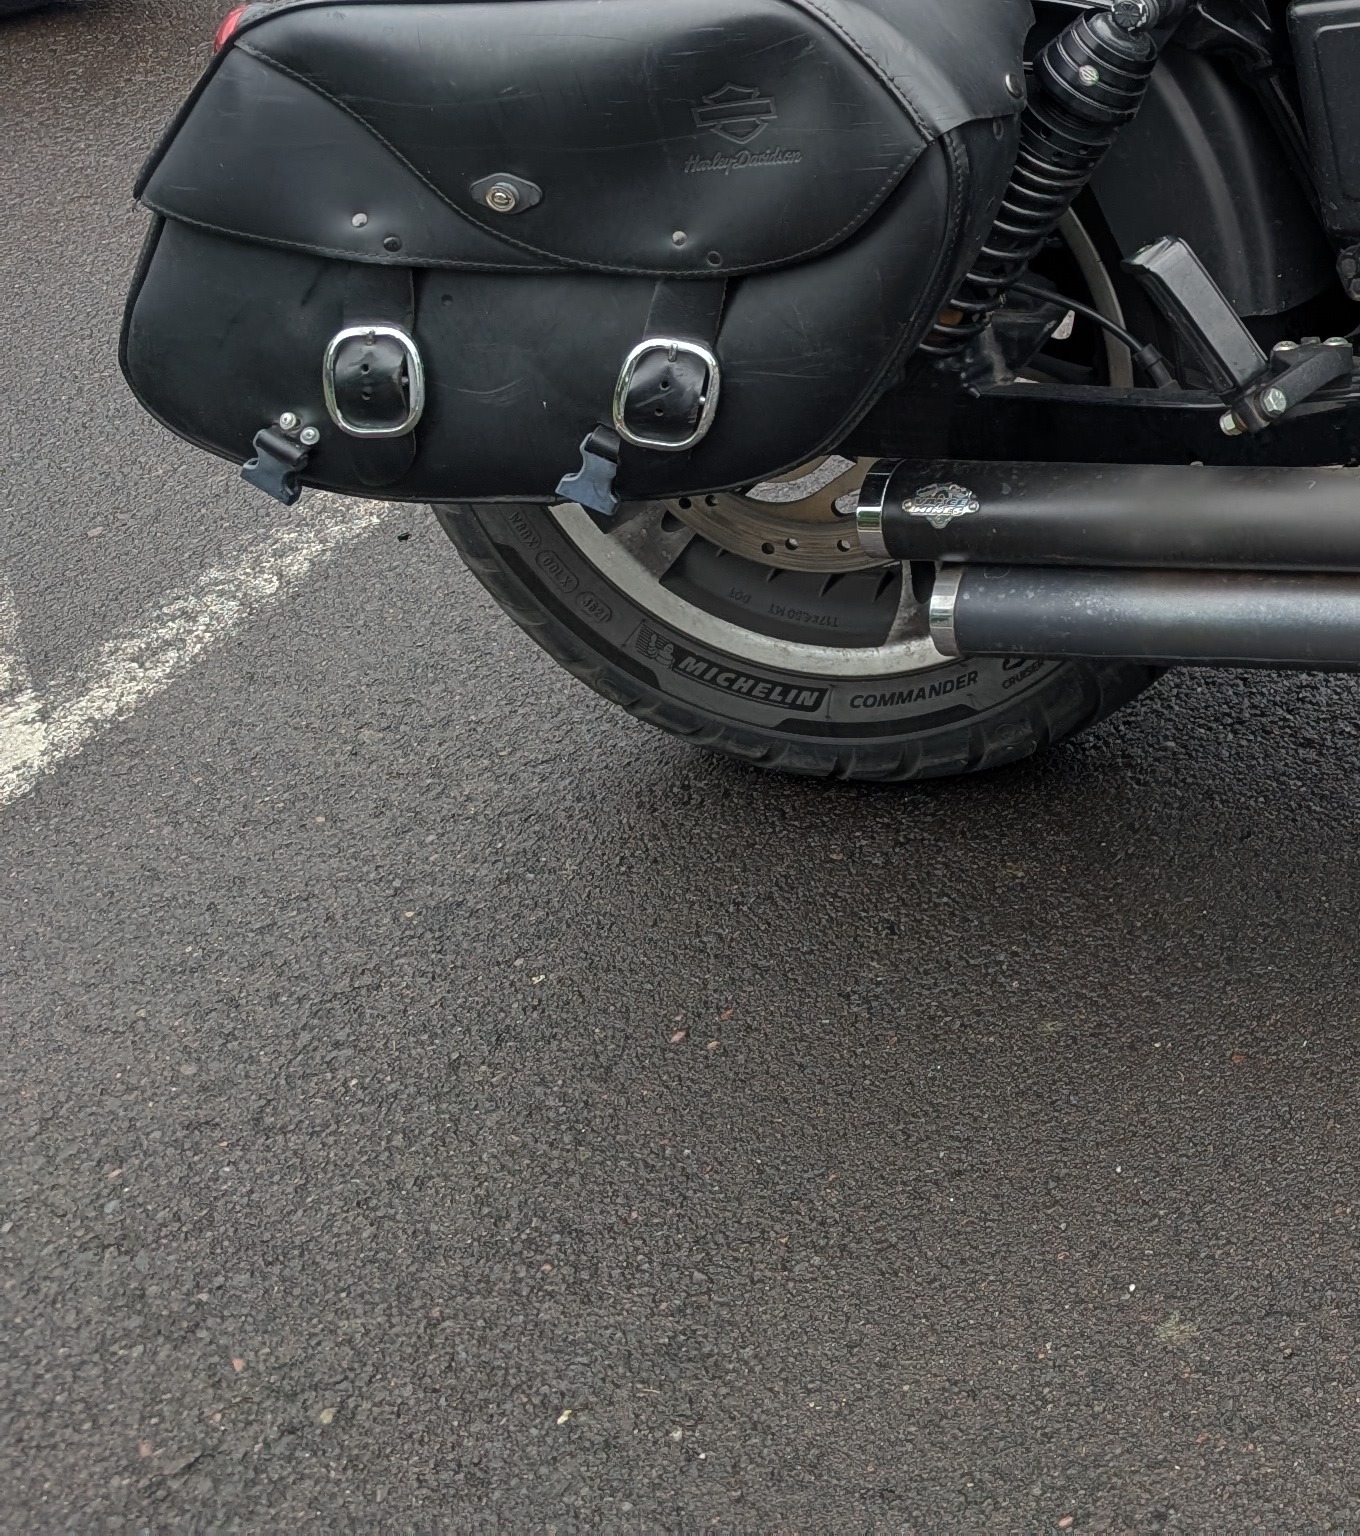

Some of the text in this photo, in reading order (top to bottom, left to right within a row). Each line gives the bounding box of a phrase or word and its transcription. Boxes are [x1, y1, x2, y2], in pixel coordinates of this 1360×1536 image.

[683, 146, 803, 176] Harley-Davidson
[678, 655, 820, 708] MICHELIN
[849, 670, 980, 710] COMMANDER
